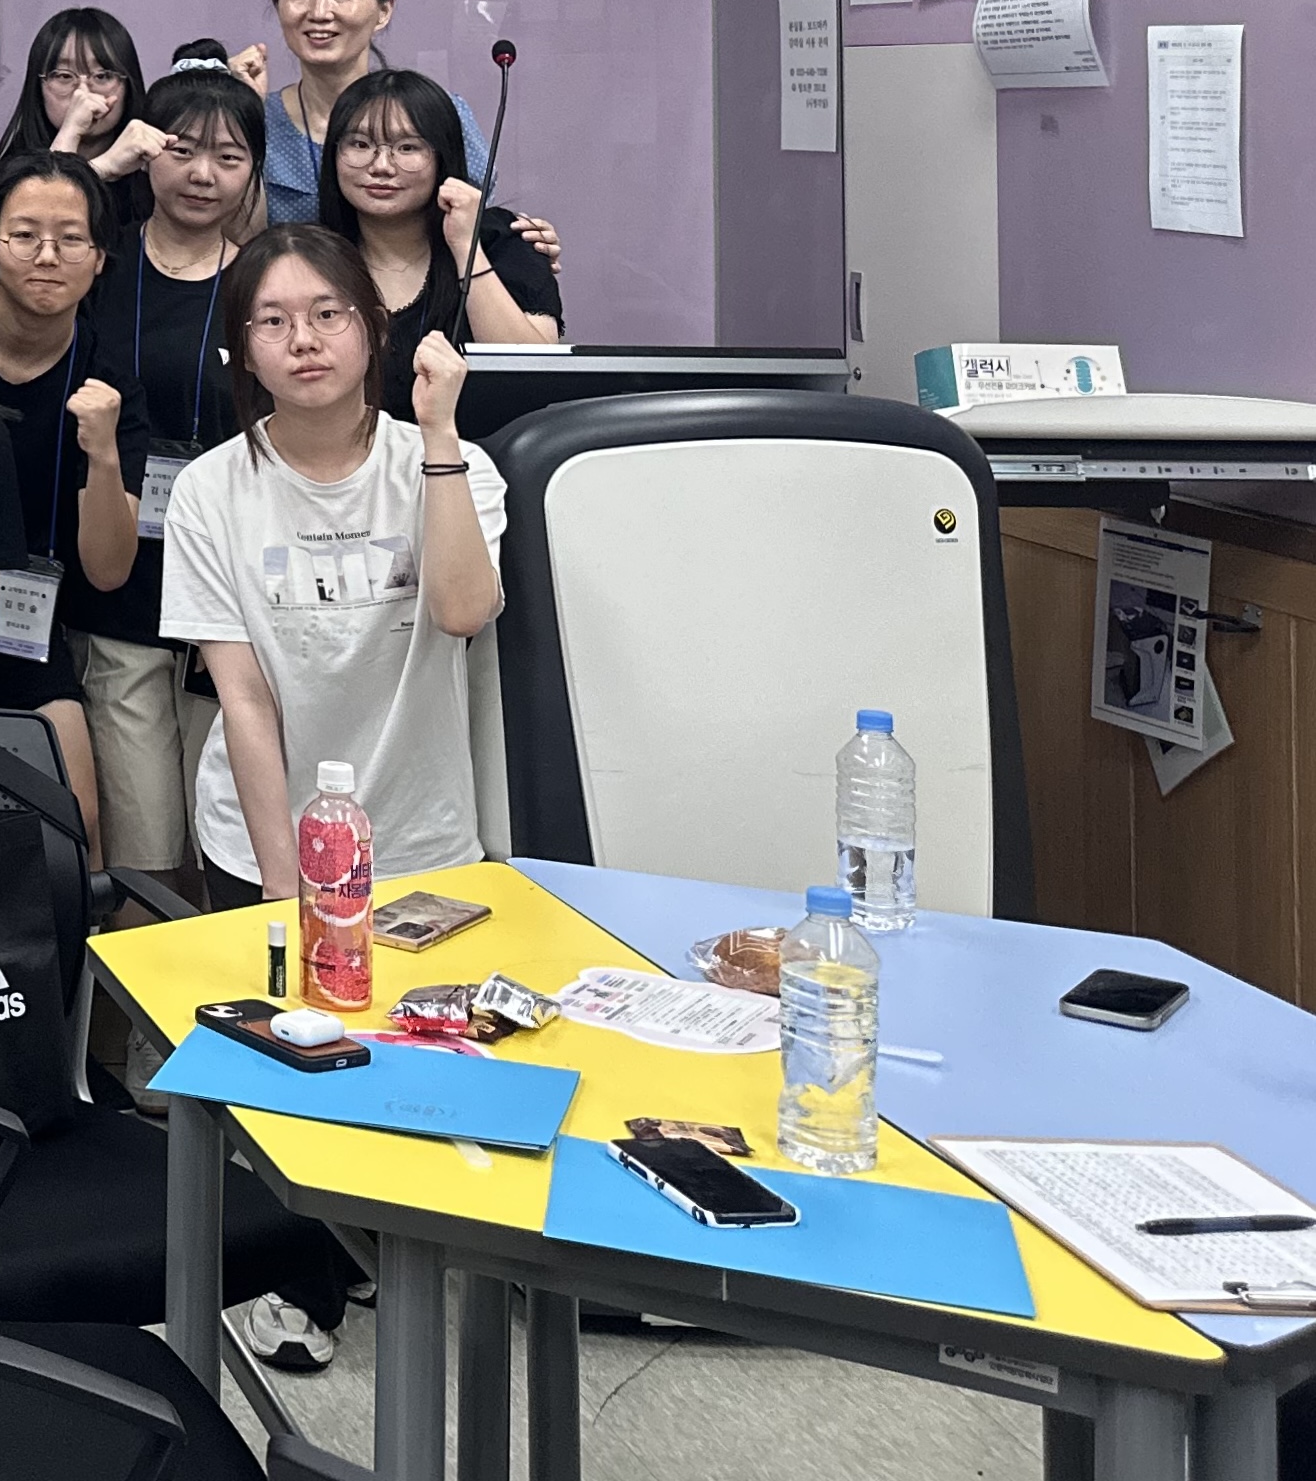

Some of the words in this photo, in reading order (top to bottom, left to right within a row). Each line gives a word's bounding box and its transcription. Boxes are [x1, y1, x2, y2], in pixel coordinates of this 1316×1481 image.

[962, 359, 1009, 378] 갤럭시
[297, 531, 333, 542] Contain
[338, 882, 373, 901] 자몽에
